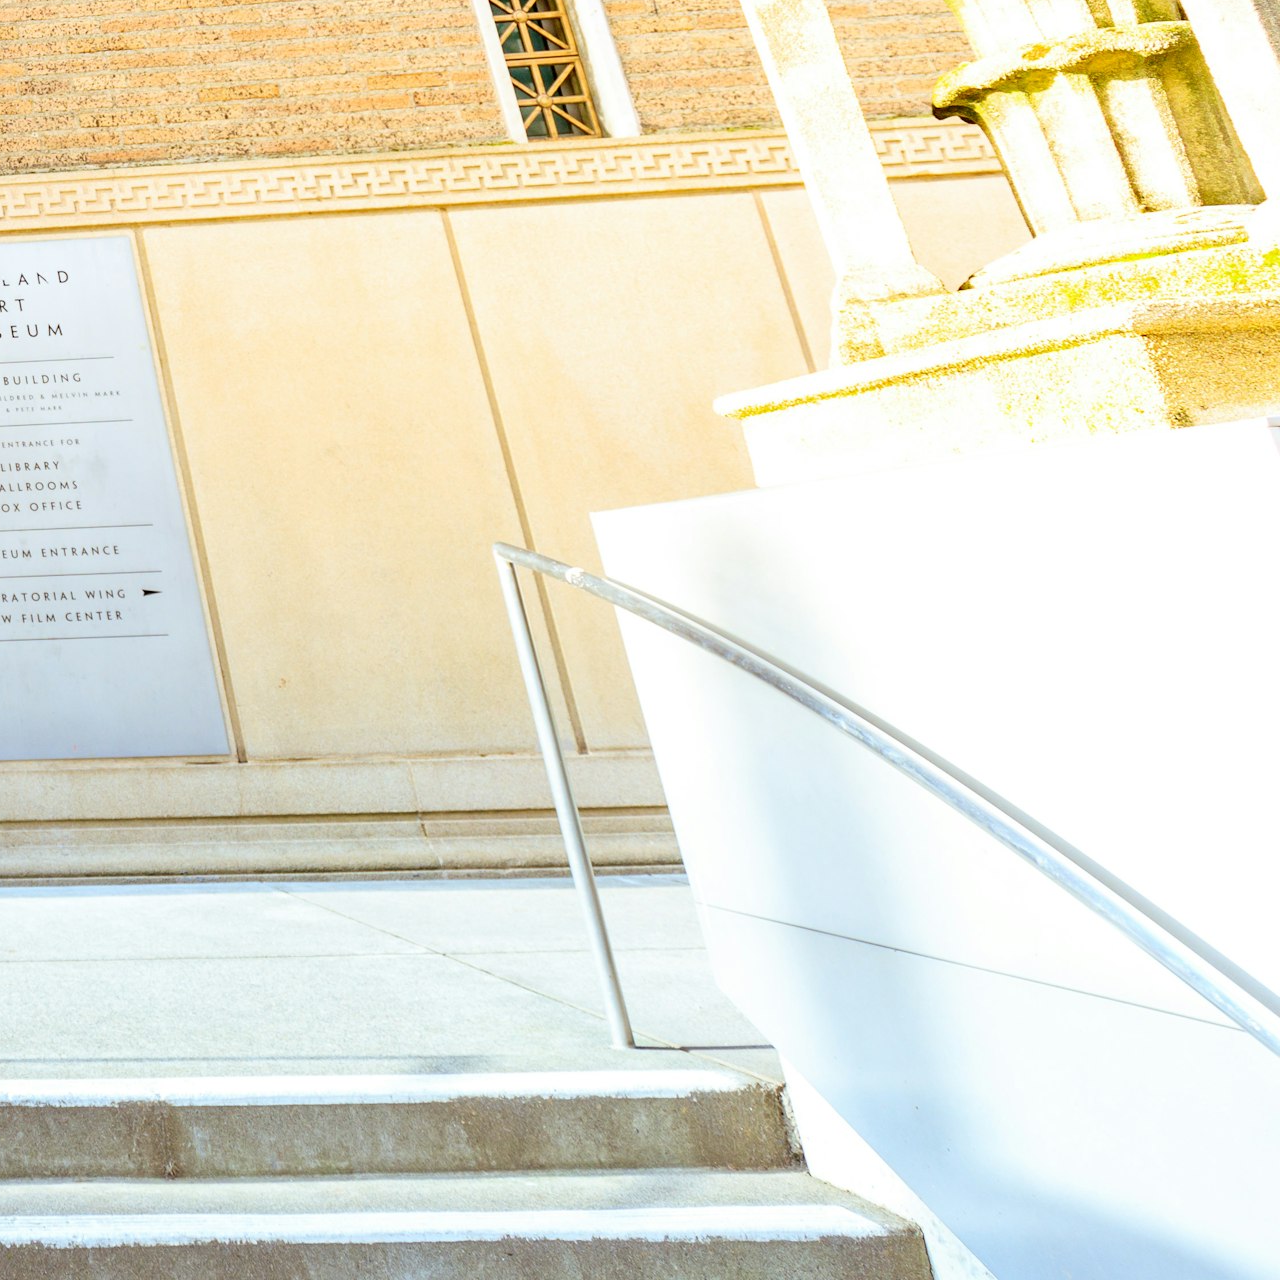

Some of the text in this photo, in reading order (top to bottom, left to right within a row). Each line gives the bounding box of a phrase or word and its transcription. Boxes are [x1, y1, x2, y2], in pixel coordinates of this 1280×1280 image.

[3, 372, 82, 386] BUILDING
[1, 439, 55, 449] ENTRANCE
[60, 438, 80, 446] FOR
[0, 460, 60, 473] LIBRARY
[29, 500, 82, 512] OFFICE
[41, 545, 121, 558] ENTRANCE
[85, 589, 127, 600] WING
[21, 612, 57, 623] FILM
[65, 610, 123, 622] CENTER
